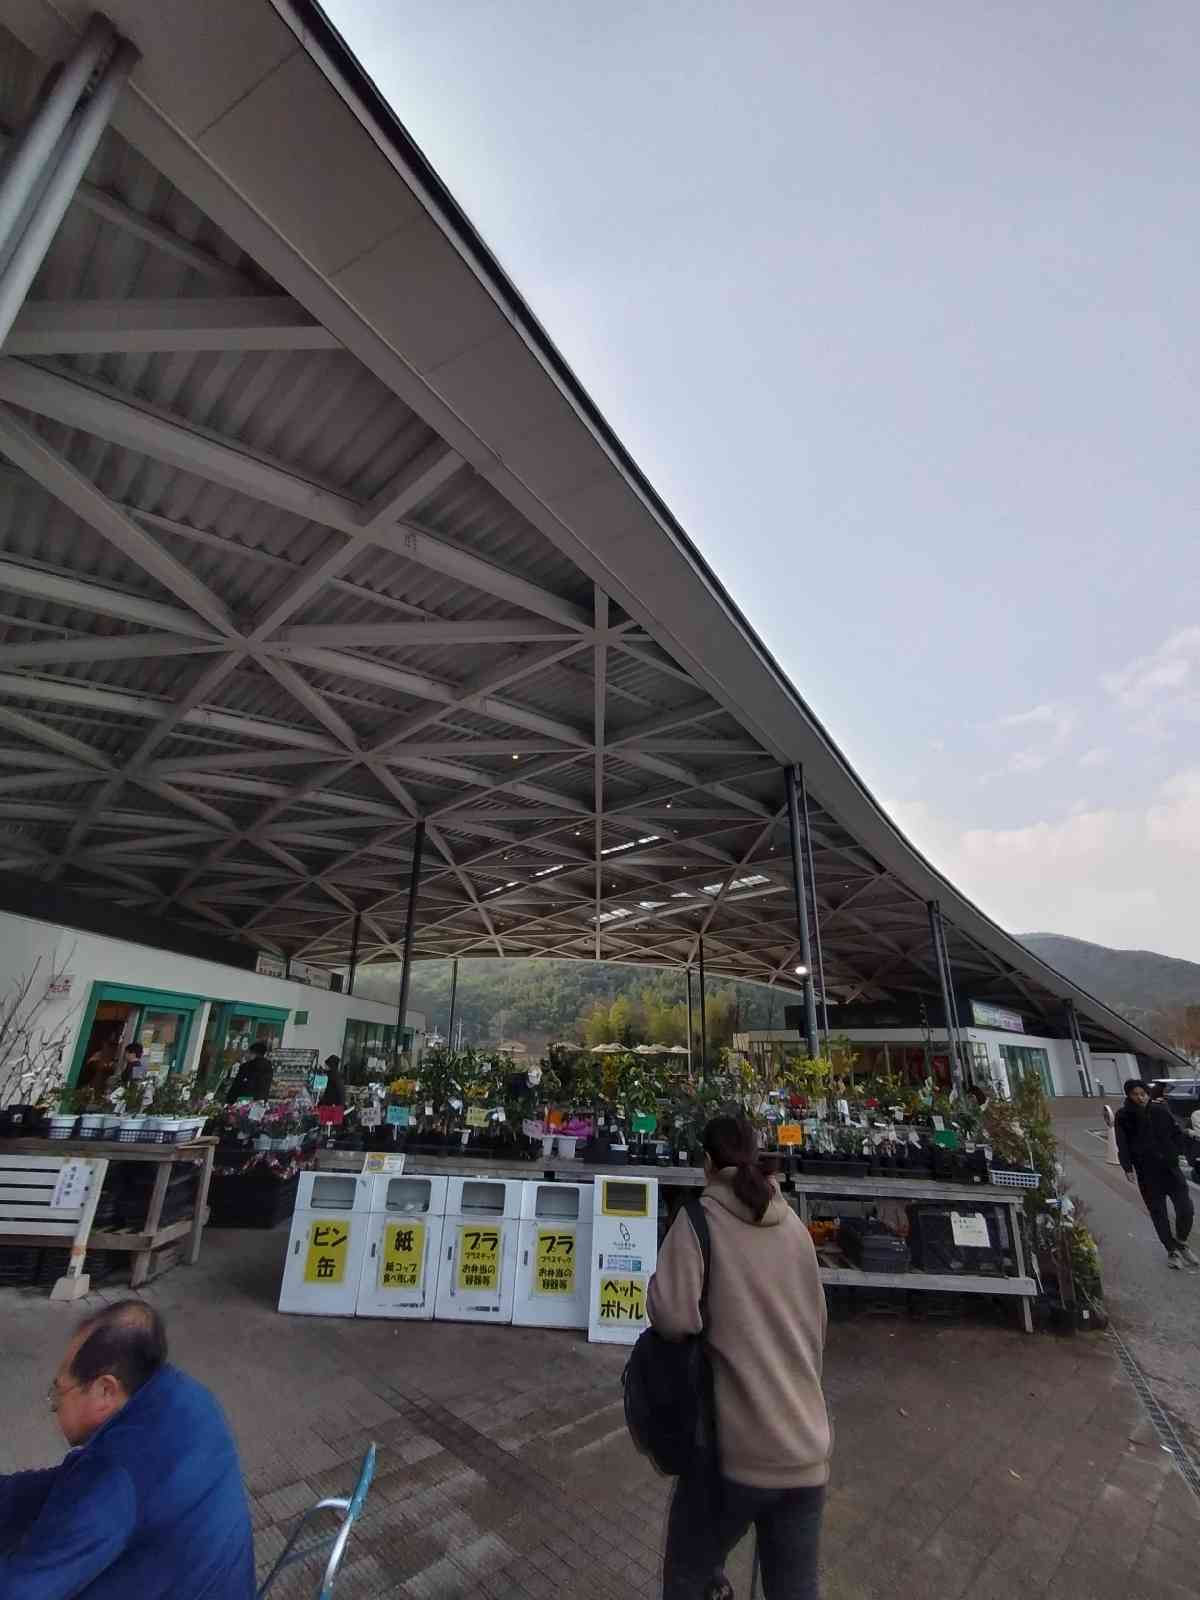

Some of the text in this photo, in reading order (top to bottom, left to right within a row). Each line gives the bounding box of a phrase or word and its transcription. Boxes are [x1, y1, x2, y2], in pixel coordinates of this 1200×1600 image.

[313, 1227, 348, 1247] ビン
[394, 1230, 414, 1252] 紙
[317, 1256, 336, 1278] 缶
[604, 1280, 642, 1297] ペット
[600, 1301, 644, 1320] ボトル
